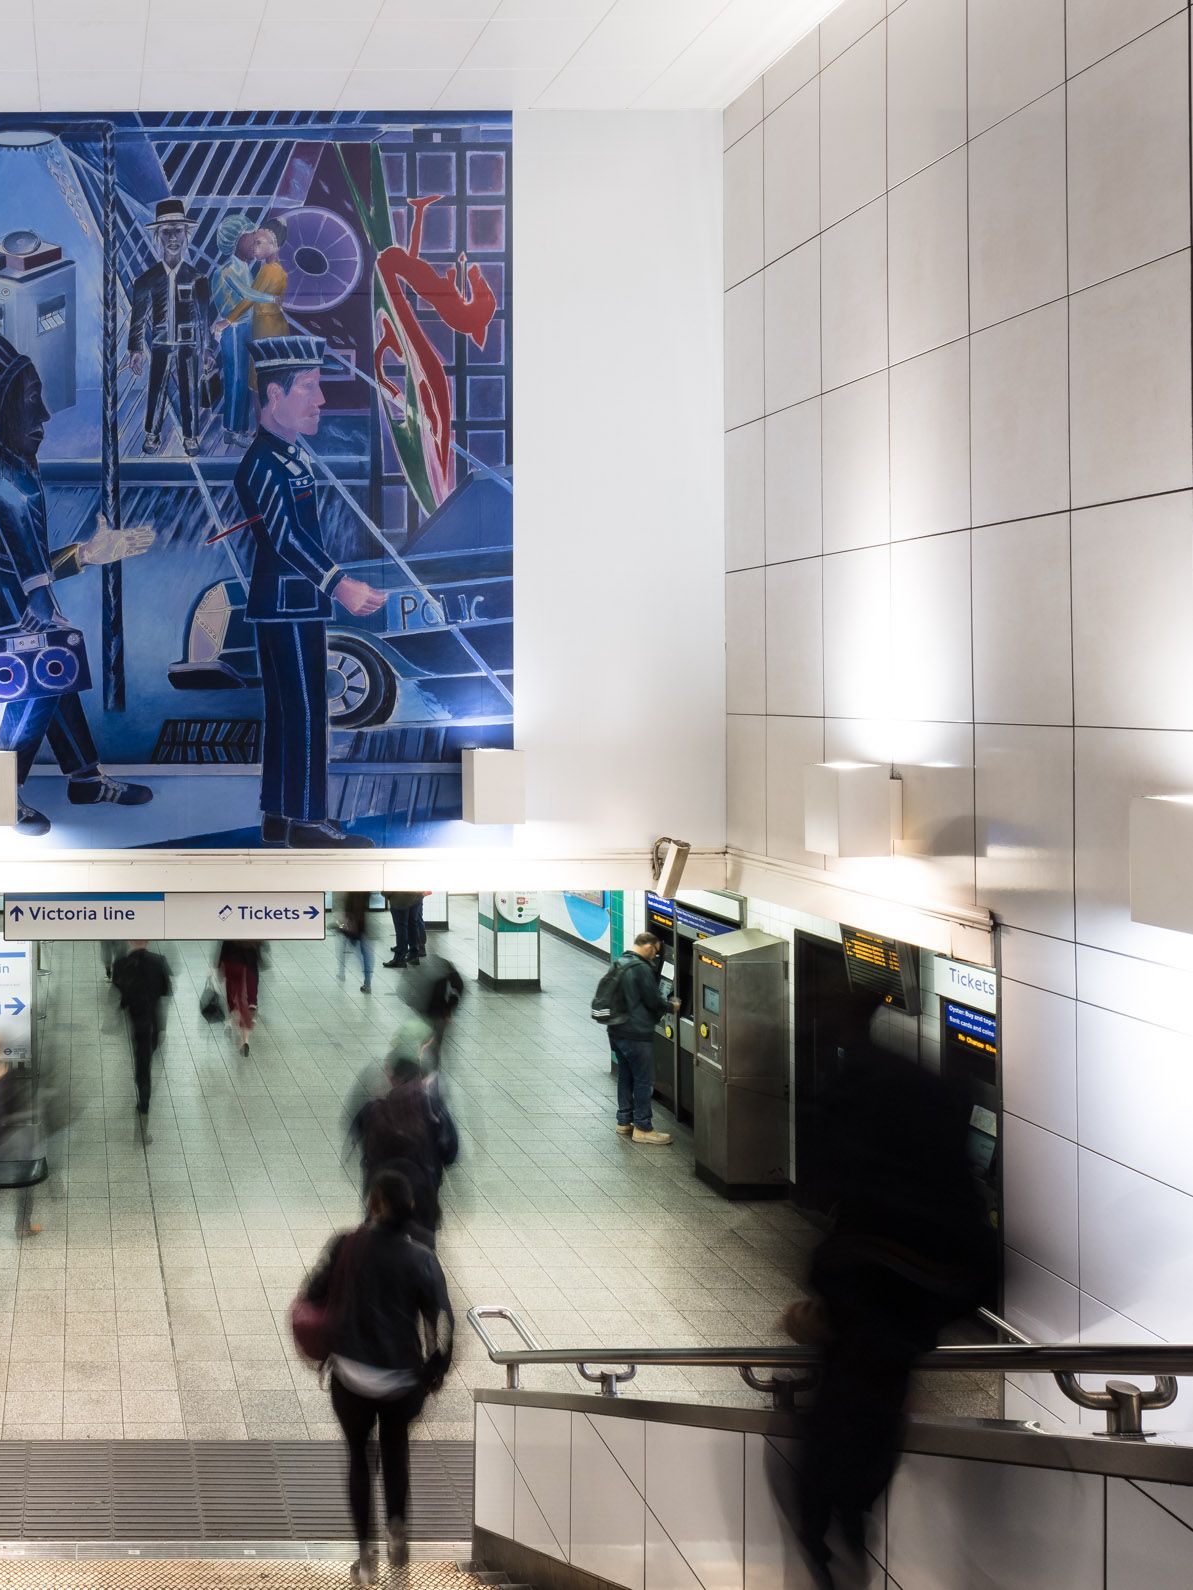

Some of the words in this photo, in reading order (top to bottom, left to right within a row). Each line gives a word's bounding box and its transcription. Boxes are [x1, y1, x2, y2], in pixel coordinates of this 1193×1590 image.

[28, 906, 97, 921] Victoria
[103, 906, 136, 921] line
[237, 905, 301, 920] Tickets
[949, 968, 995, 995] Tickets
